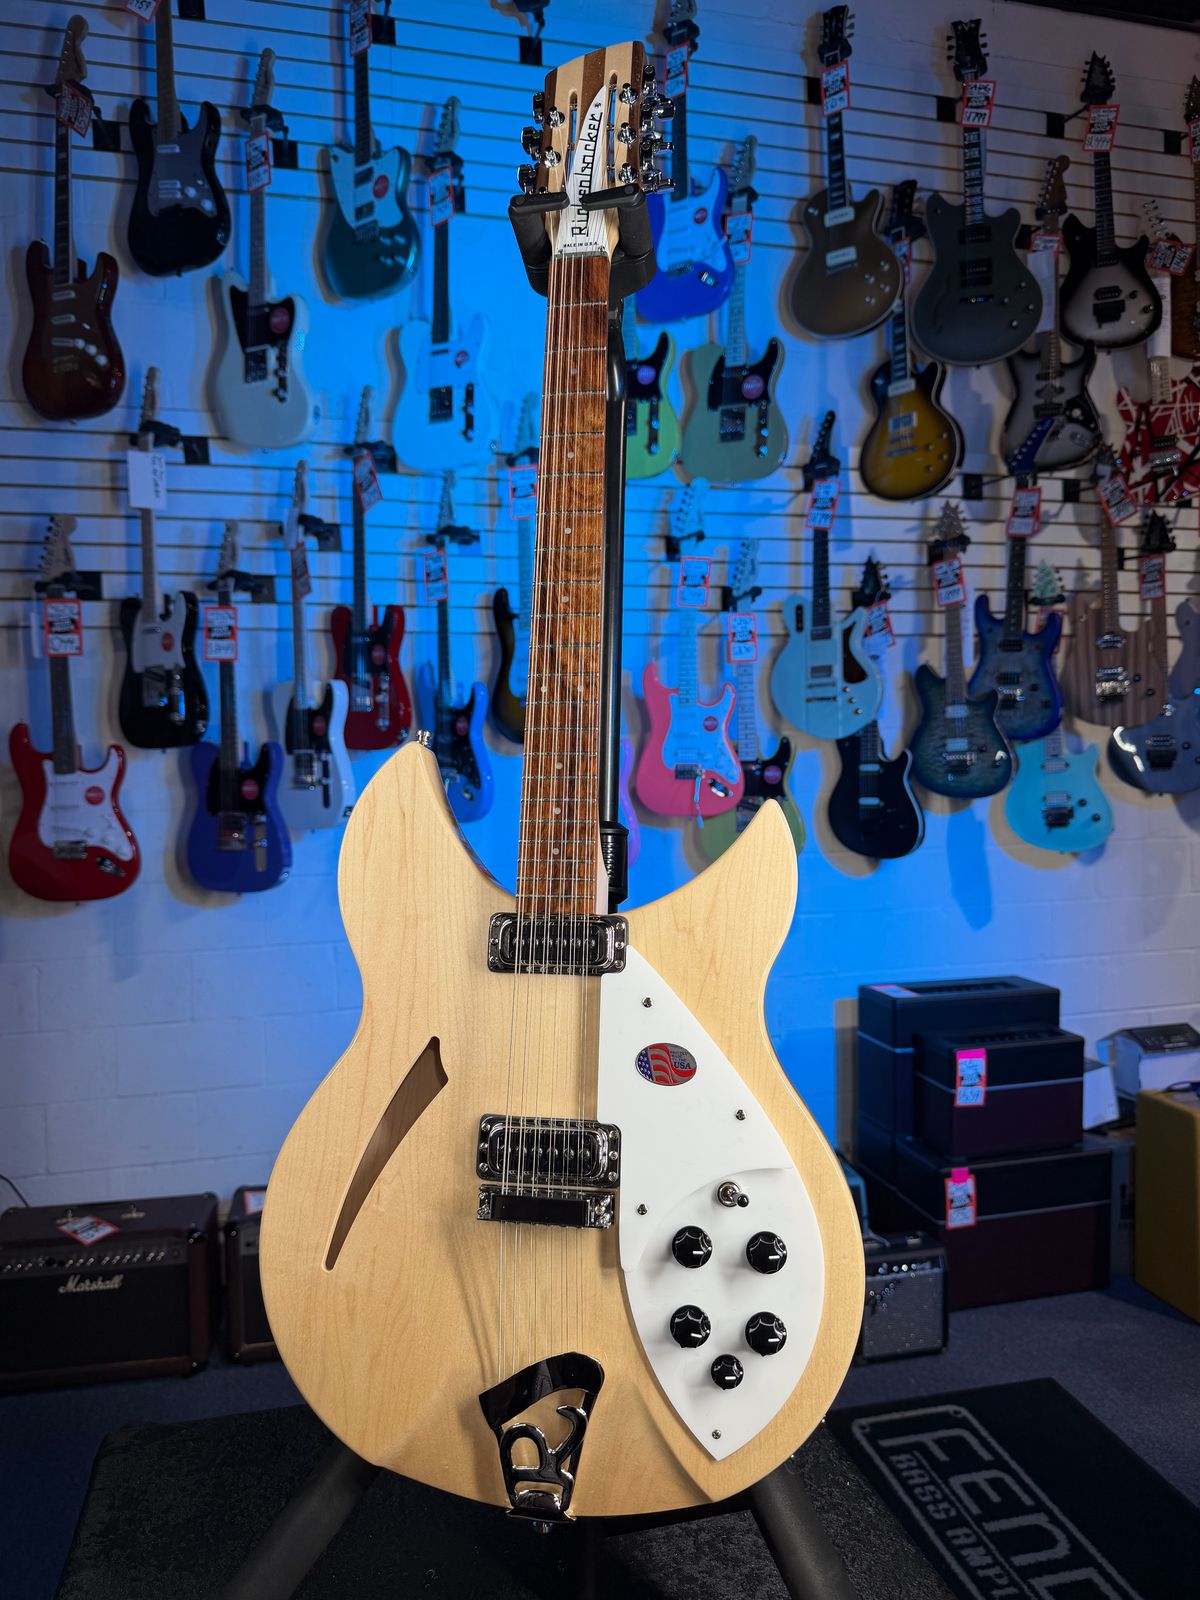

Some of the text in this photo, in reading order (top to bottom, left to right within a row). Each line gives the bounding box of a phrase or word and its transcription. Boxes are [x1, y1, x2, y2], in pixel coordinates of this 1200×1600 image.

[674, 1061, 692, 1070] USA
[58, 1274, 124, 1293] Marshall
[888, 1453, 957, 1520] BASS
